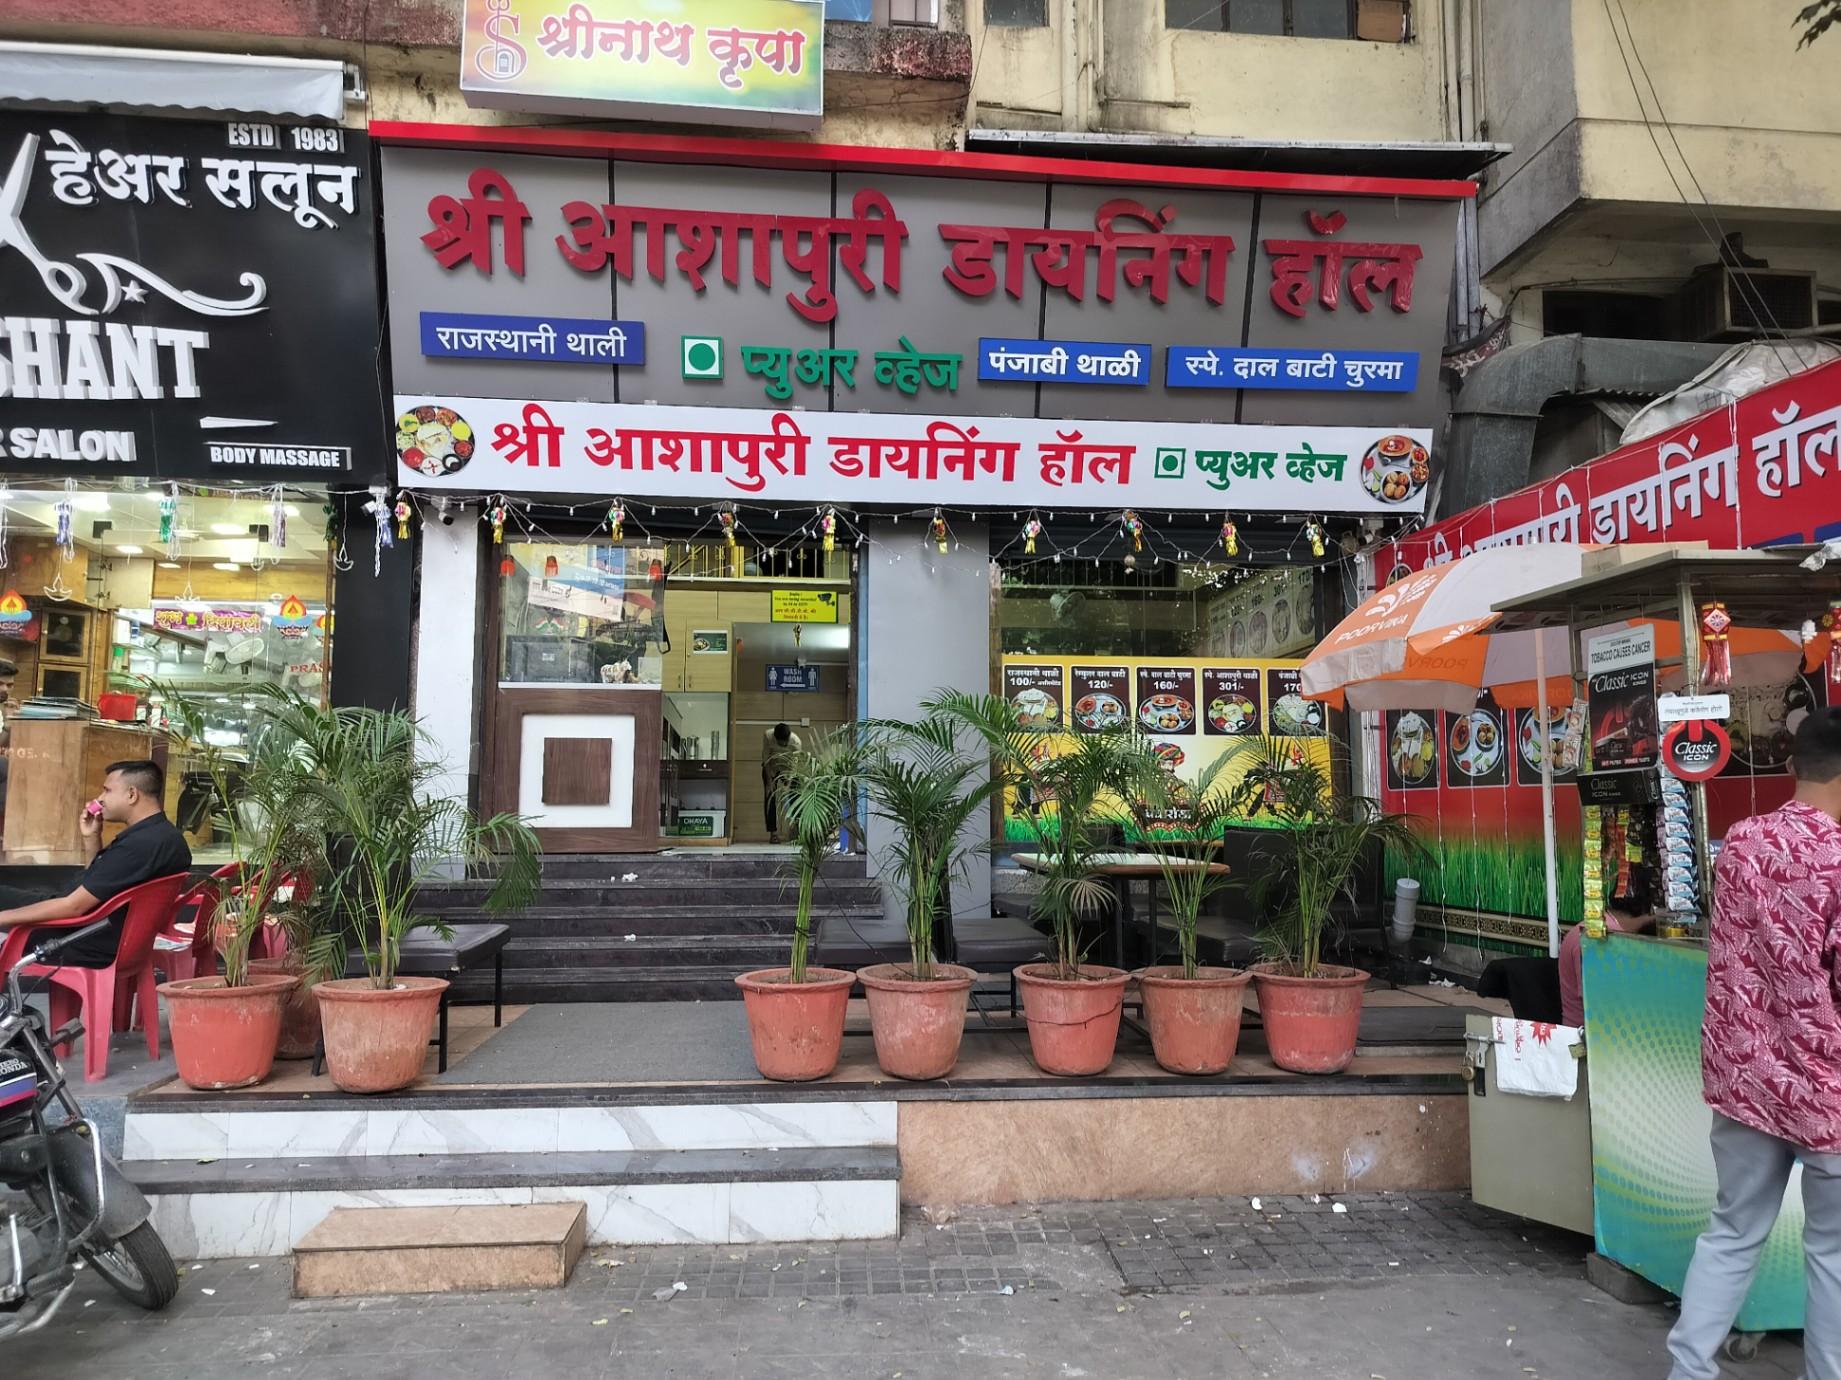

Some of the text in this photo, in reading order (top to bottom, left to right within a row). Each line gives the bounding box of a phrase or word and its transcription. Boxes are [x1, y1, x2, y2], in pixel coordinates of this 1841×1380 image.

[537, 4, 805, 88] श्रीनाथ कृपा
[228, 122, 339, 152] ESTD 1983
[45, 129, 358, 229] हेअर सलून
[420, 168, 1423, 323] श्री आशापुरी डायनिंग हॉल
[437, 317, 627, 358] राजस्थानी थाली
[0, 316, 209, 399] HANT
[741, 335, 962, 400] प्युअर व्हेज
[989, 347, 1141, 379] पंजाबी थाळी
[1234, 356, 1277, 379] दाल
[1287, 352, 1337, 381] बाटी
[1344, 360, 1403, 387] चुरमा
[10, 427, 137, 462] SALON
[210, 447, 340, 468] BODY MASSAGE
[490, 403, 1137, 492] श्री आशापुरी डायनिंग हॉल
[1195, 441, 1348, 491] प्युअर व्हेज
[1590, 434, 1739, 544] डायनिंग
[1752, 400, 1841, 498] हॉल
[1591, 648, 1613, 665] TOBACCO
[1613, 644, 1631, 660] CAUSES
[1631, 640, 1651, 656] CANCER
[1009, 677, 1036, 686] 100/-
[1087, 679, 1115, 689] 120/-
[1153, 680, 1180, 691] 160/-
[1218, 681, 1245, 691] 301/-
[1595, 671, 1649, 693] Classic ICON
[1674, 741, 1718, 755] Classic
